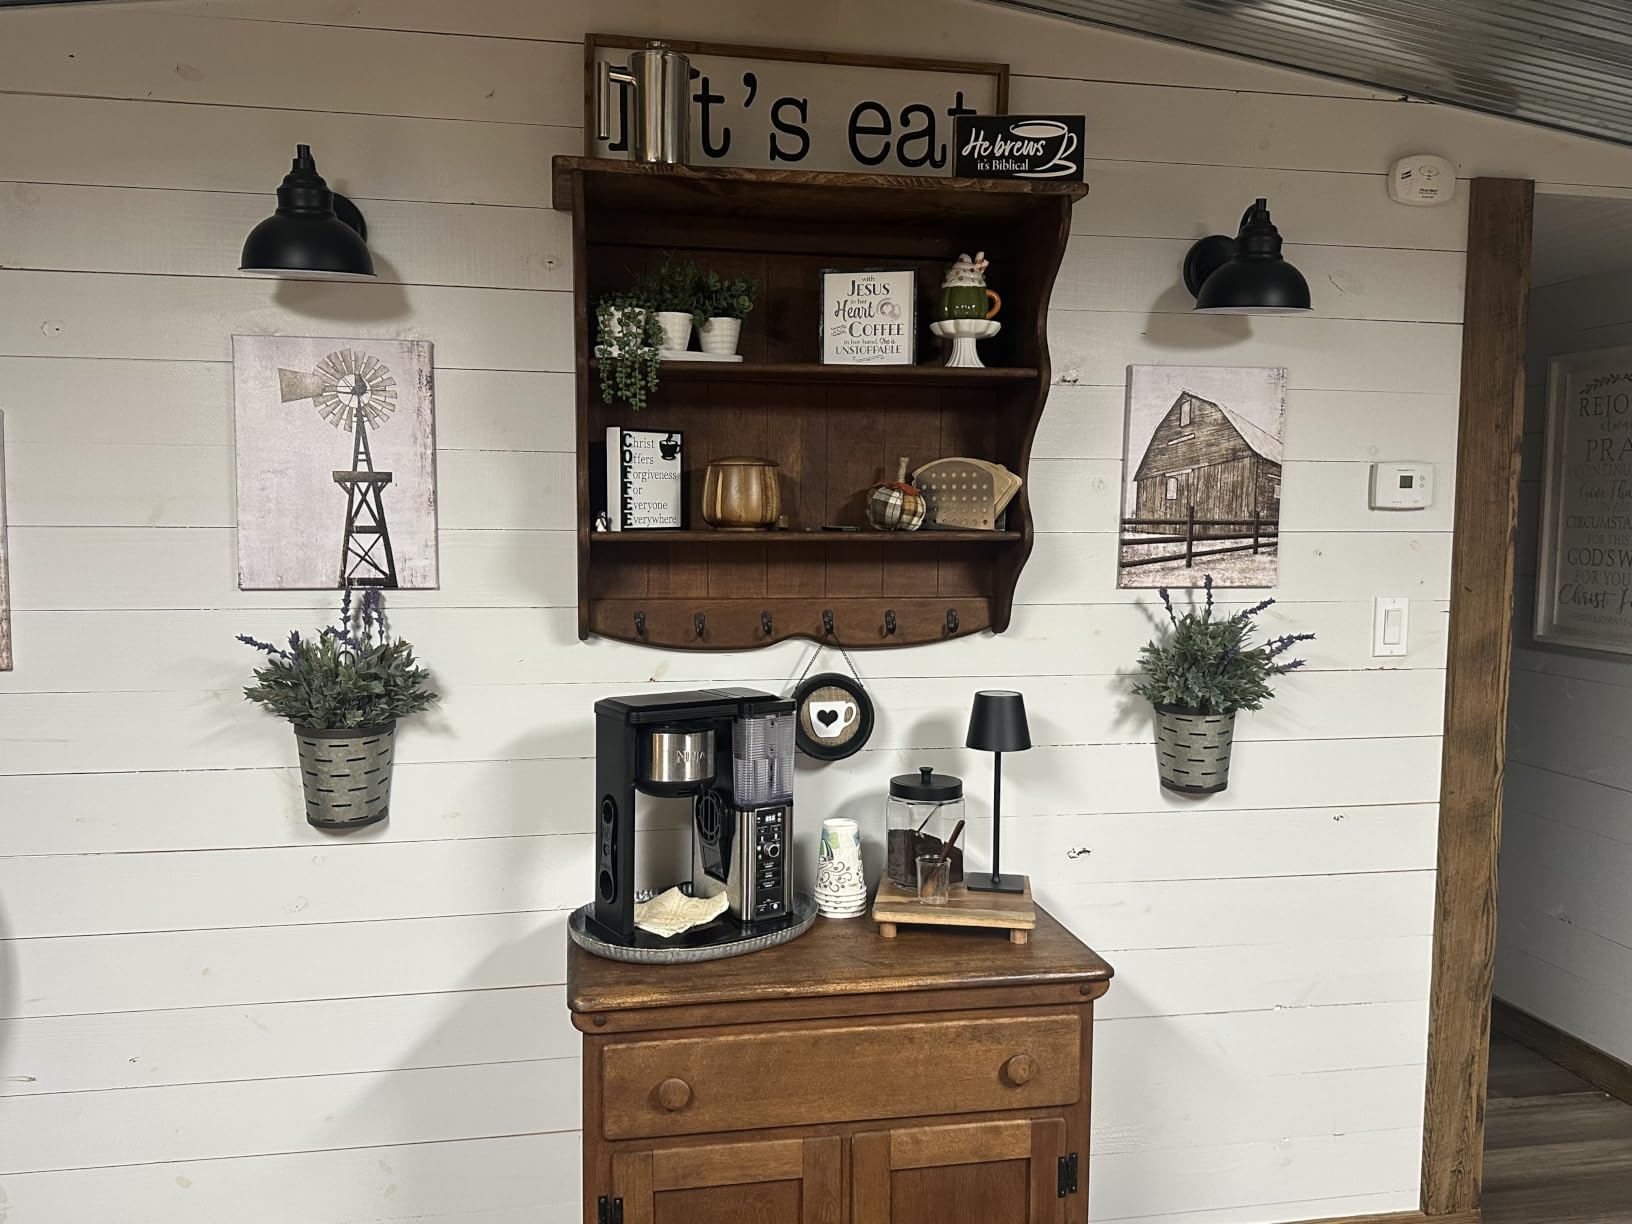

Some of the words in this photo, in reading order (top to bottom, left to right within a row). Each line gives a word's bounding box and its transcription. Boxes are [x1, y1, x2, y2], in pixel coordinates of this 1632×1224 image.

[961, 127, 993, 159] He
[993, 133, 1046, 157] brews
[977, 158, 990, 171] it's
[992, 158, 1029, 171] Biblical
[847, 280, 890, 297] JESUS
[834, 300, 876, 322] Heart
[849, 321, 905, 338] COFFEE
[835, 345, 902, 355] UNSTOPPABLE
[1579, 393, 1632, 417] REJO
[623, 432, 655, 449] Christ
[623, 449, 655, 465] Offers
[1584, 437, 1632, 463] PRA
[624, 465, 677, 483] Forgiveness
[624, 496, 668, 512] Everyone
[624, 511, 677, 527] Everywhere
[1566, 515, 1632, 529] CIRCUMSTA
[1559, 584, 1616, 609] Christ
